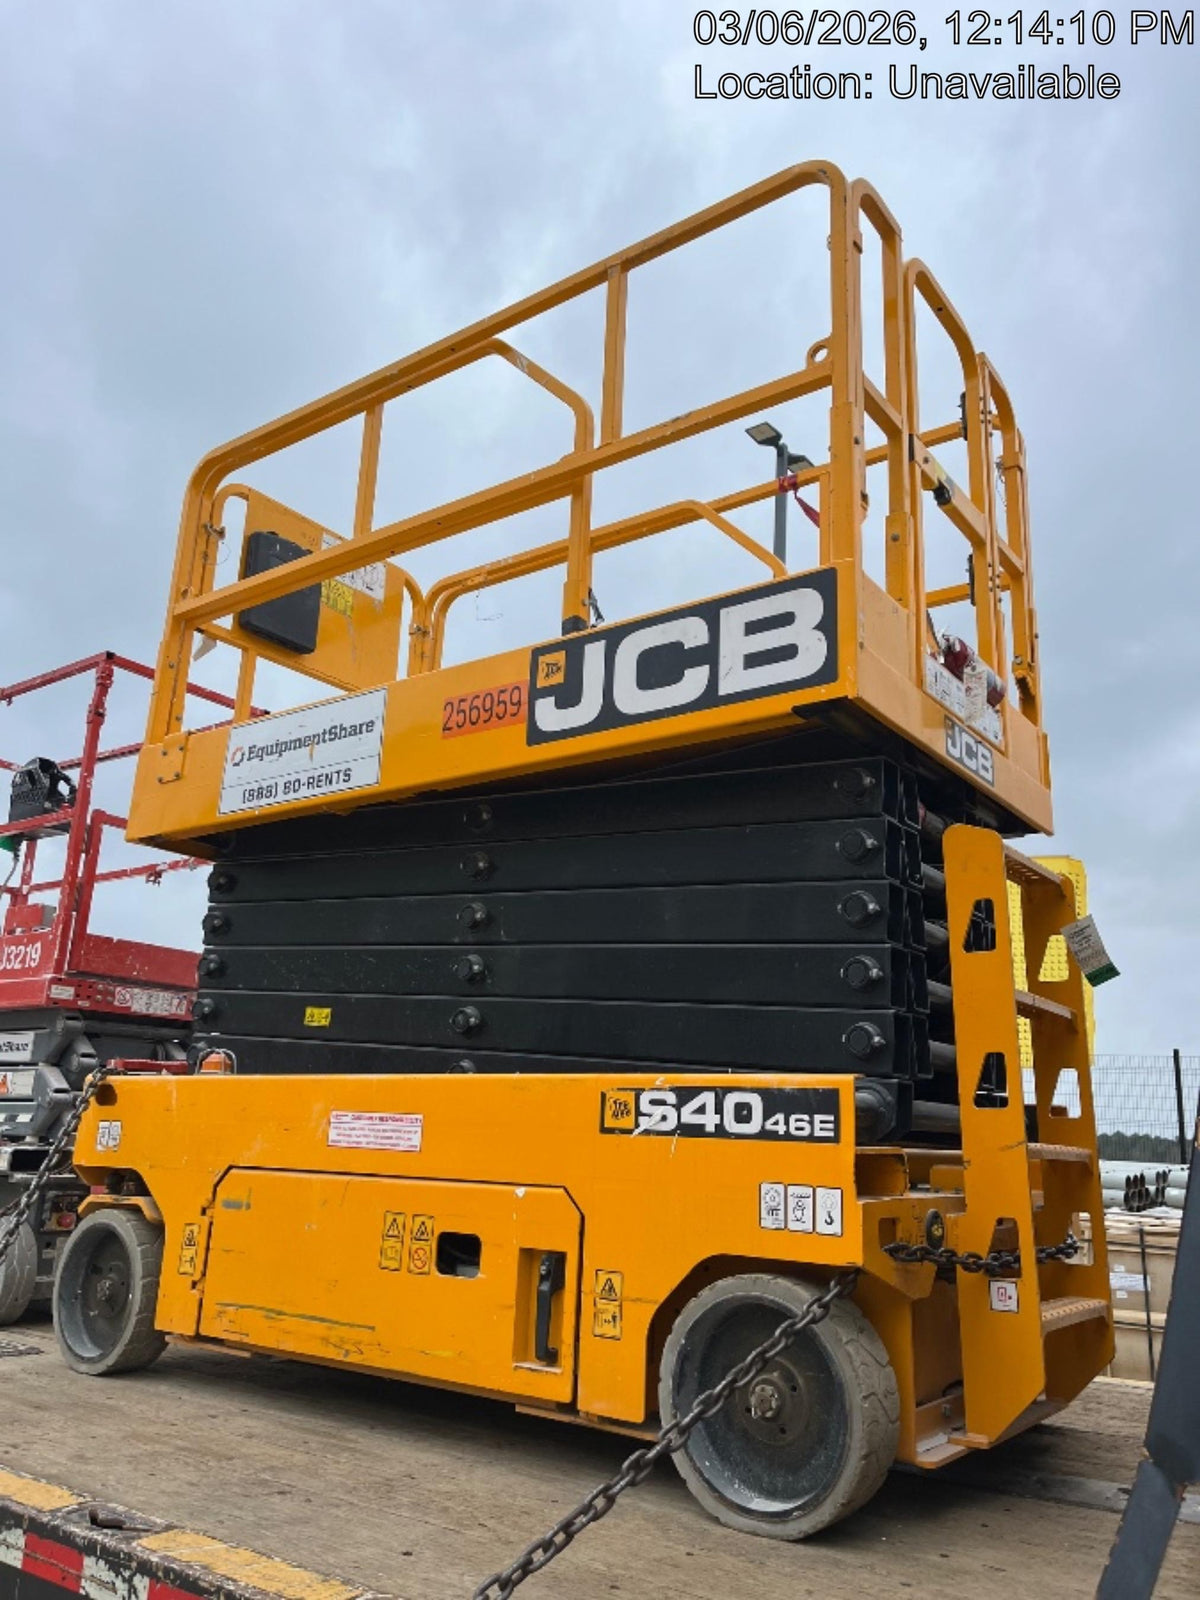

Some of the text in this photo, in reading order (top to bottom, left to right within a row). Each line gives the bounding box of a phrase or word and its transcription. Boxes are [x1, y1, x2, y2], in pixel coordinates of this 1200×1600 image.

[535, 588, 828, 732] JCB
[442, 686, 522, 732] 256959
[246, 719, 376, 762] EquipmentShare
[947, 726, 993, 782] JCB
